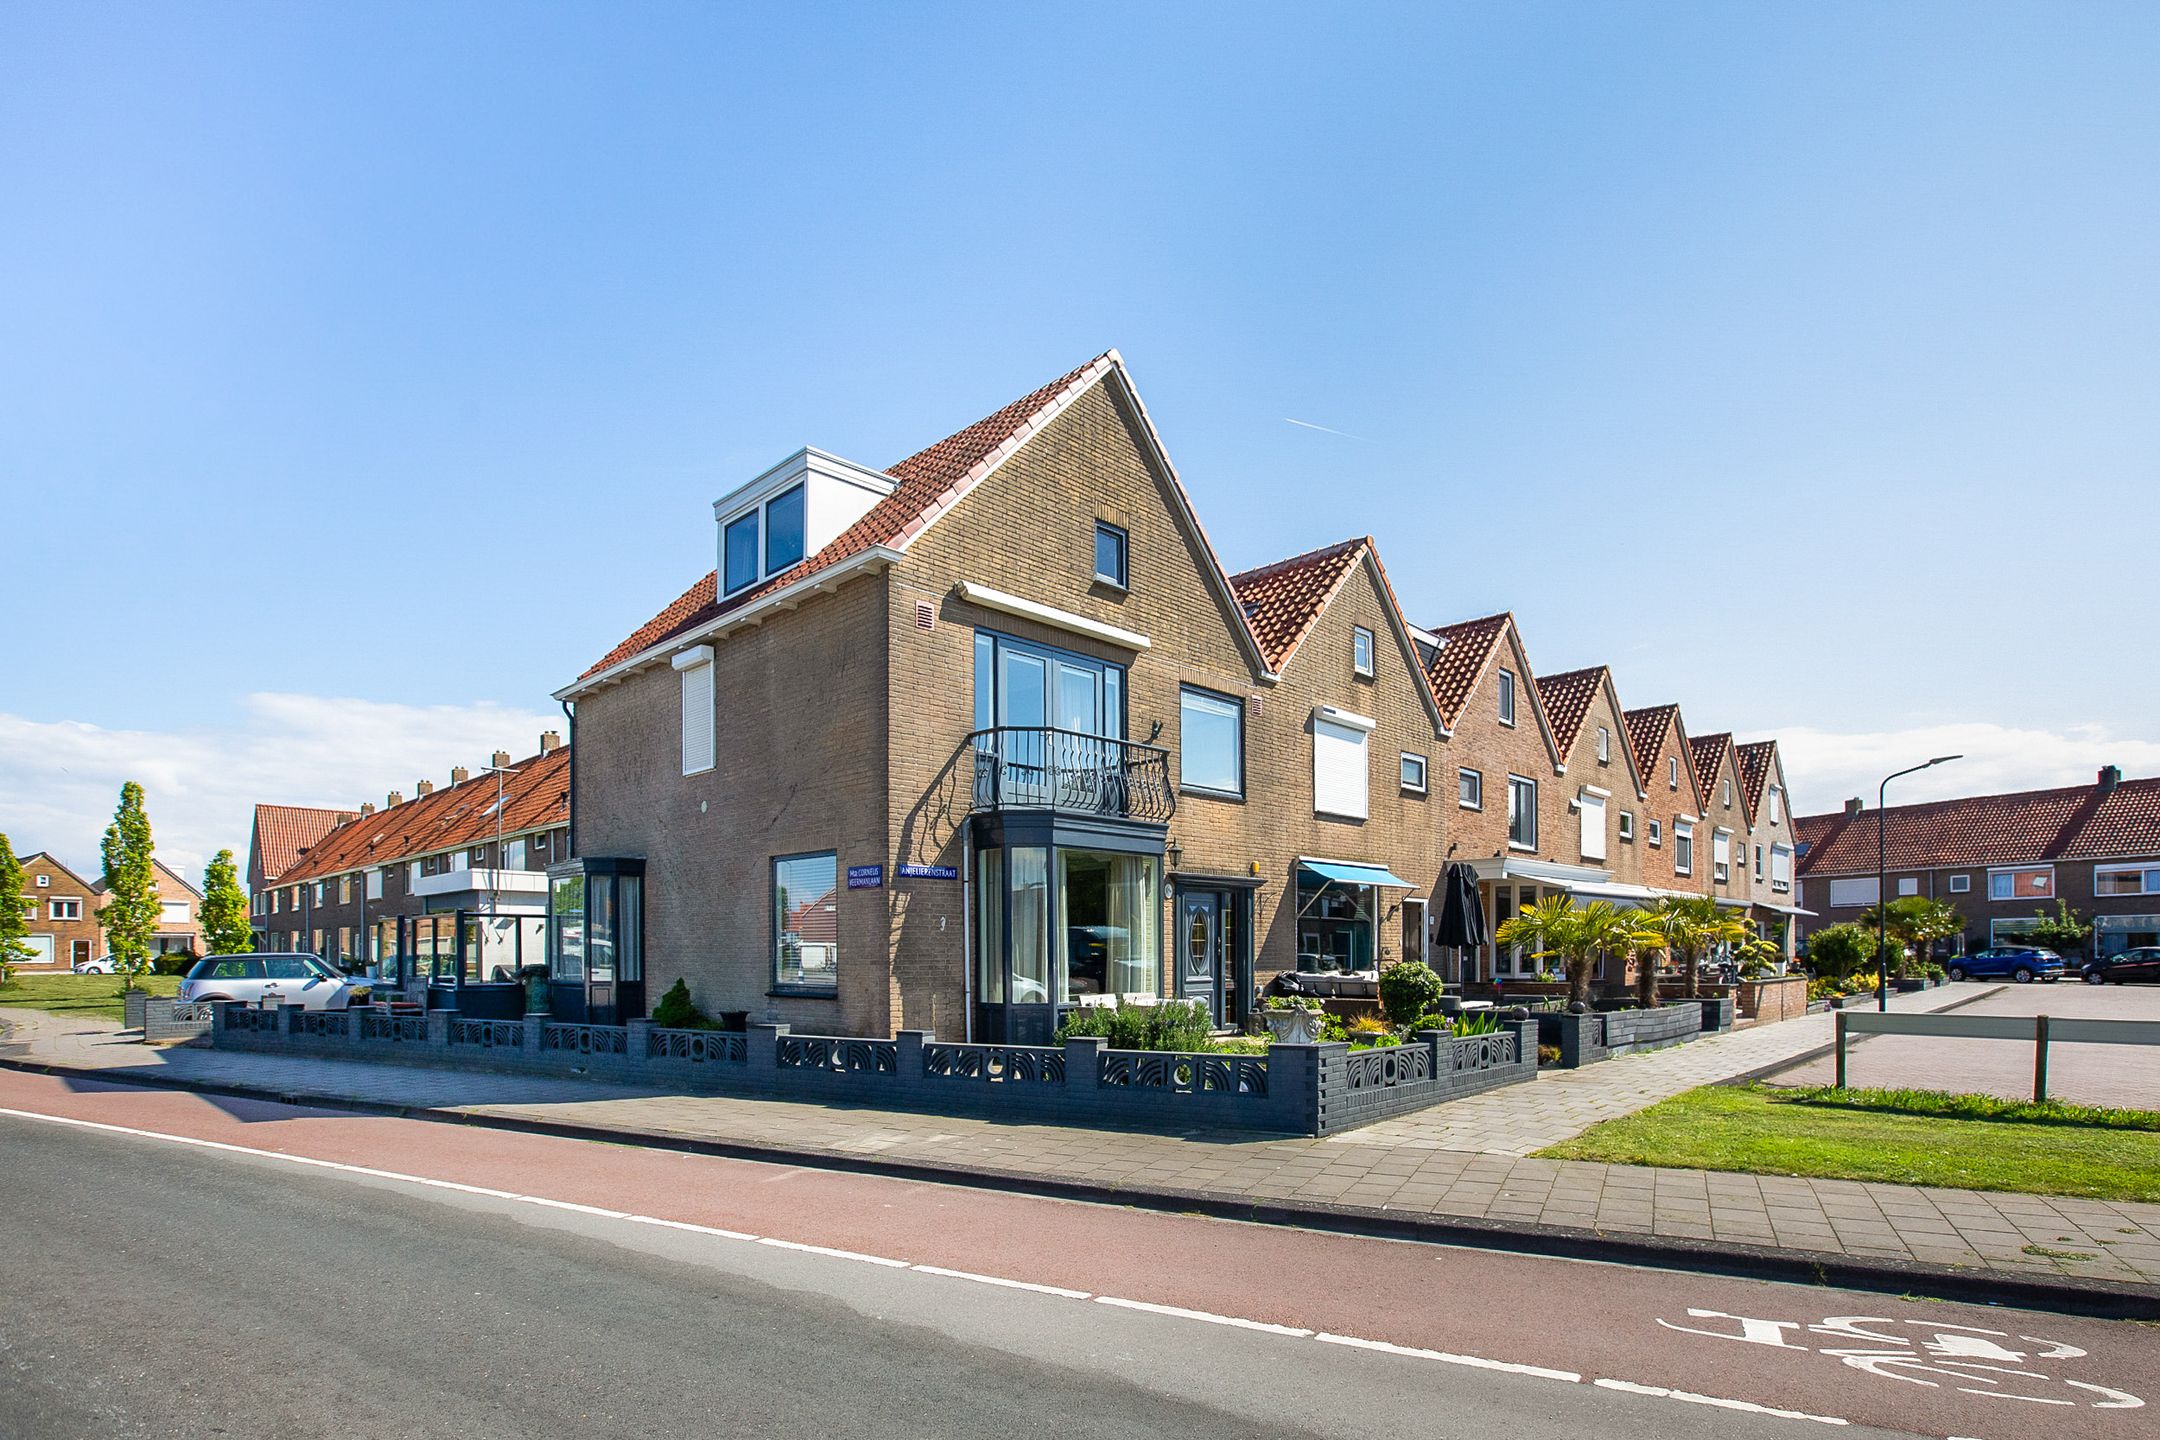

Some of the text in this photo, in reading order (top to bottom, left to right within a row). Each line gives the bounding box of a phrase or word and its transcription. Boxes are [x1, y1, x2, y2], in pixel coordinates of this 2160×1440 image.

[858, 867, 879, 876] CORNELIS
[901, 866, 956, 878] ANJELIERENSTRAAT
[849, 877, 880, 887] VEERMANLAAN
